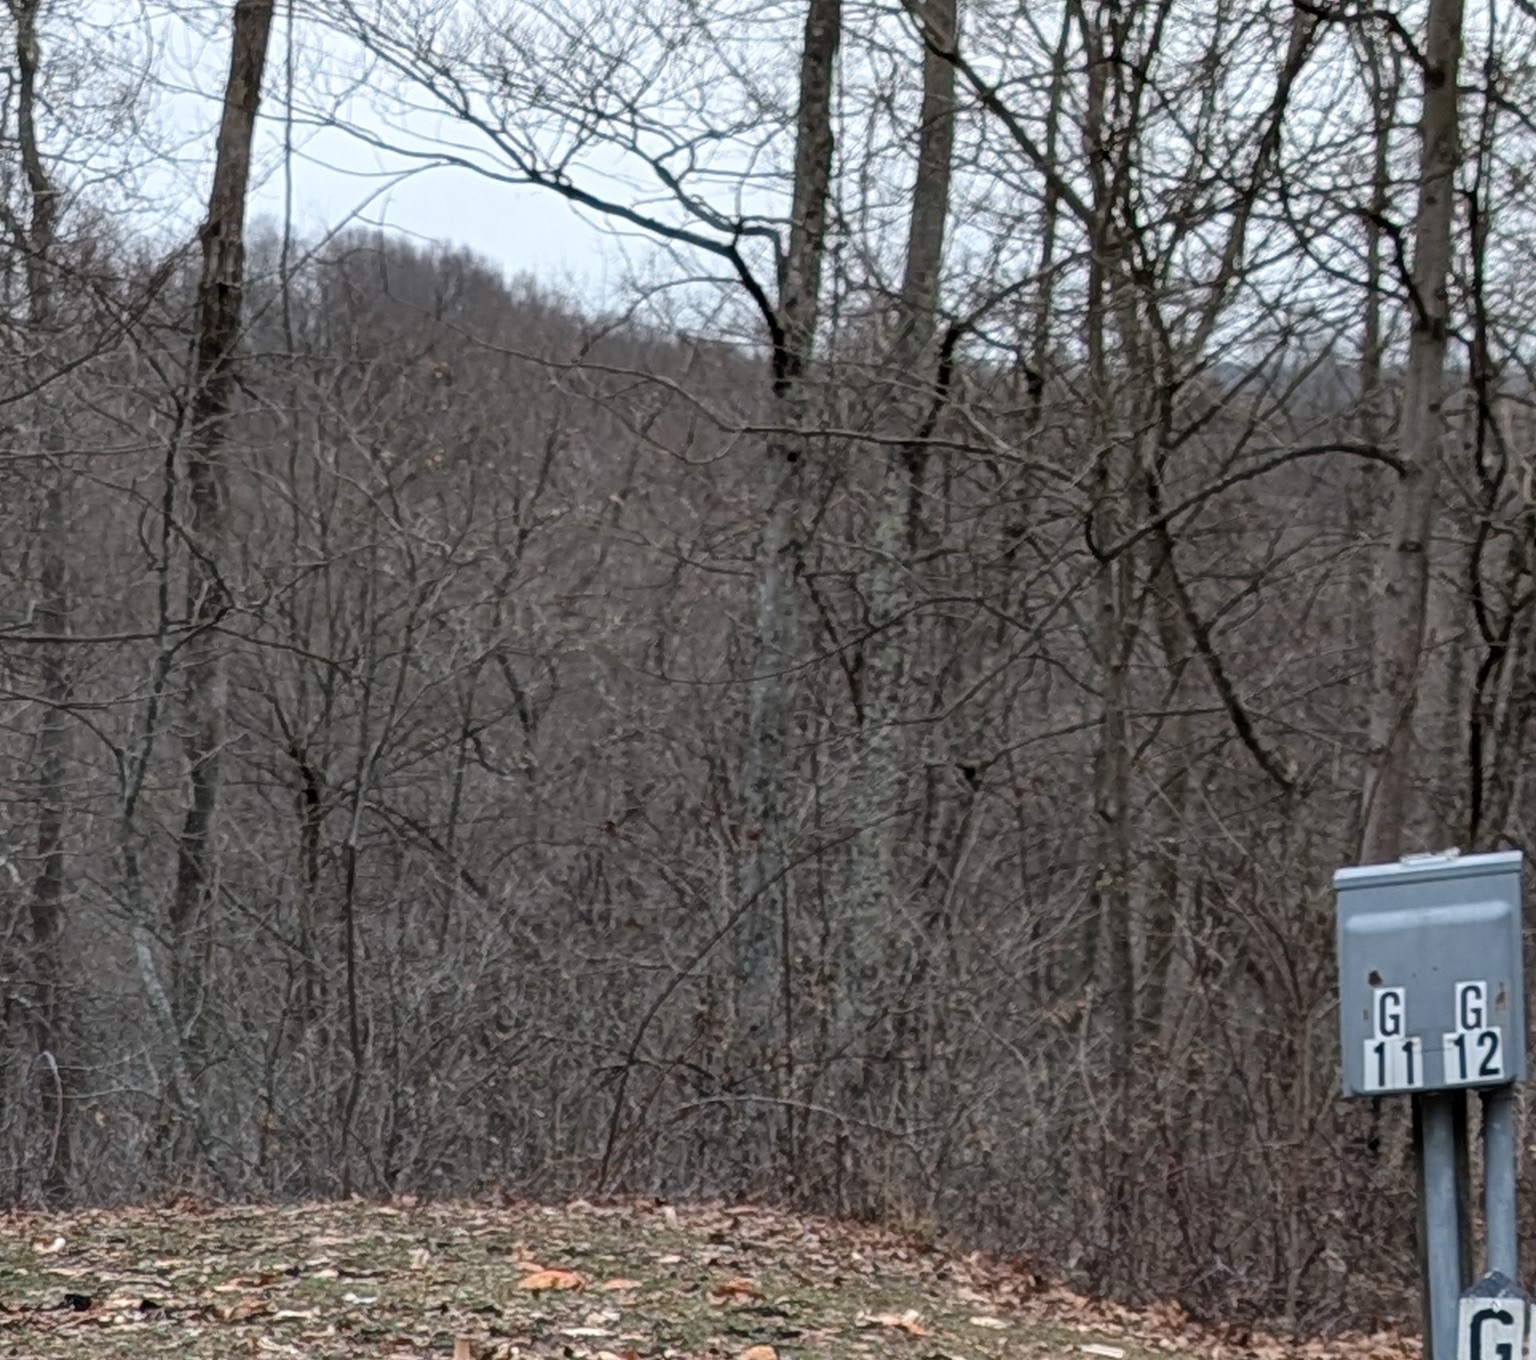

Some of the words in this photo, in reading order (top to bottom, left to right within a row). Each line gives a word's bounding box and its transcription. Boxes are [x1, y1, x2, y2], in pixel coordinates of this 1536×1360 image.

[1379, 991, 1401, 1037] G
[1460, 984, 1483, 1031] G
[1373, 1041, 1414, 1087] 11
[1454, 1030, 1501, 1080] 12
